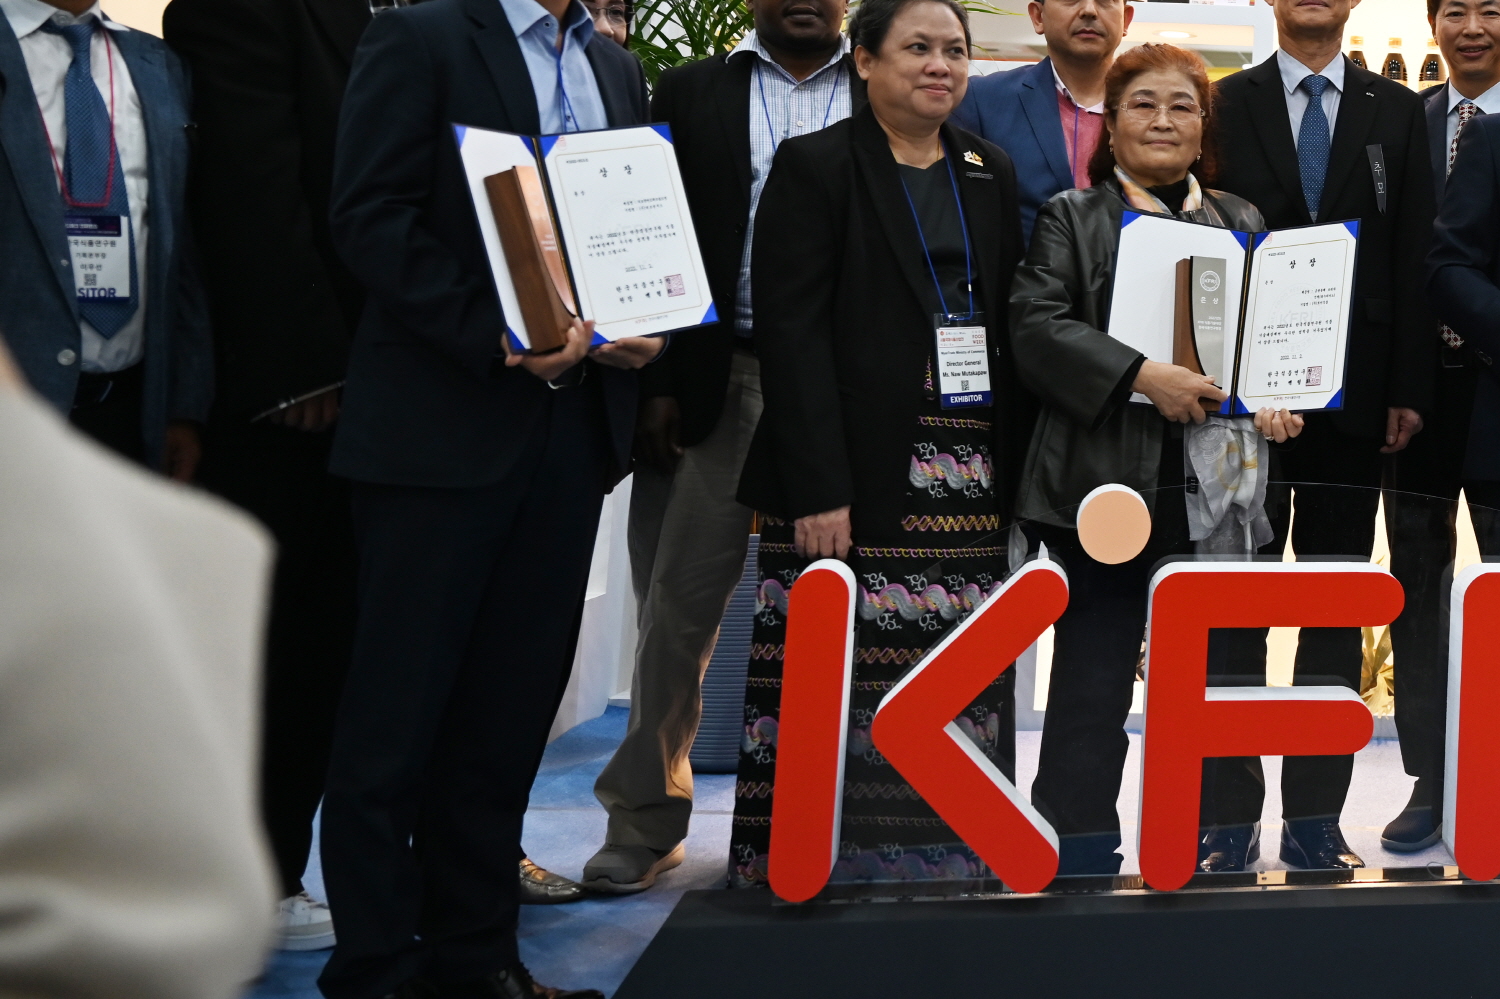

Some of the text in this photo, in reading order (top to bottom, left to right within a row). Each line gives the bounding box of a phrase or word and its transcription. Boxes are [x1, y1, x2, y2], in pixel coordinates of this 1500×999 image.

[77, 287, 117, 298] SITOR
[1200, 296, 1219, 305] 은 상
[950, 394, 983, 404] EXHIBITOR
